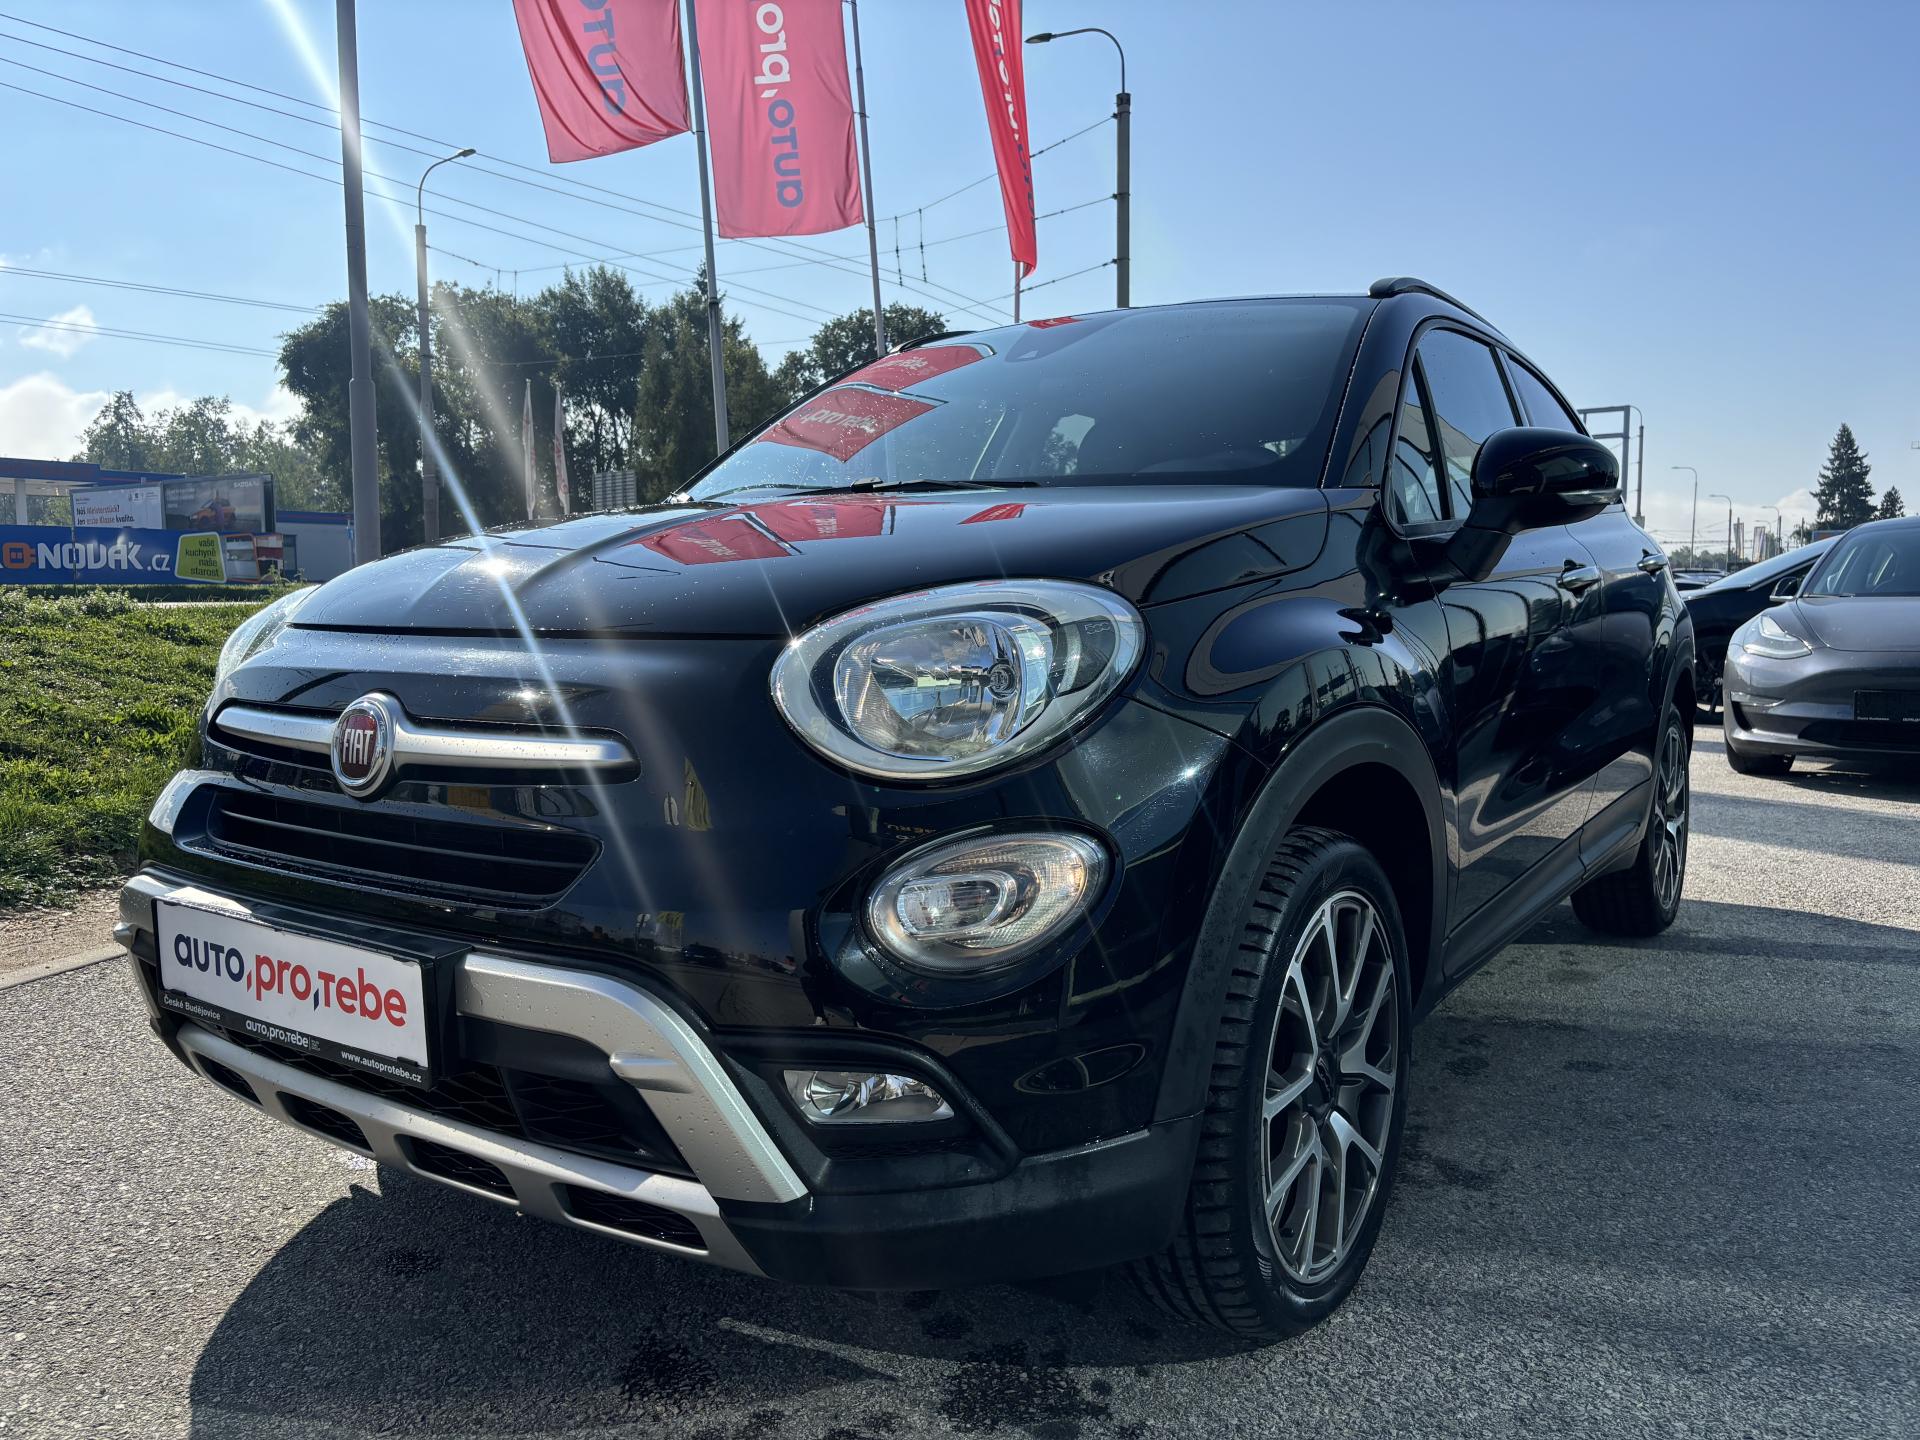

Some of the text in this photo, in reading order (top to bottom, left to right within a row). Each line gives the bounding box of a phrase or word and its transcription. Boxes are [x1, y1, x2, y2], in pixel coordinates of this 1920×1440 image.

[186, 548, 216, 558] kuchyně
[190, 567, 219, 577] starost
[342, 728, 374, 765] FIAT
[163, 994, 221, 1020] České Budějovice
[341, 1050, 422, 1083] www.autoprotebe.cz
